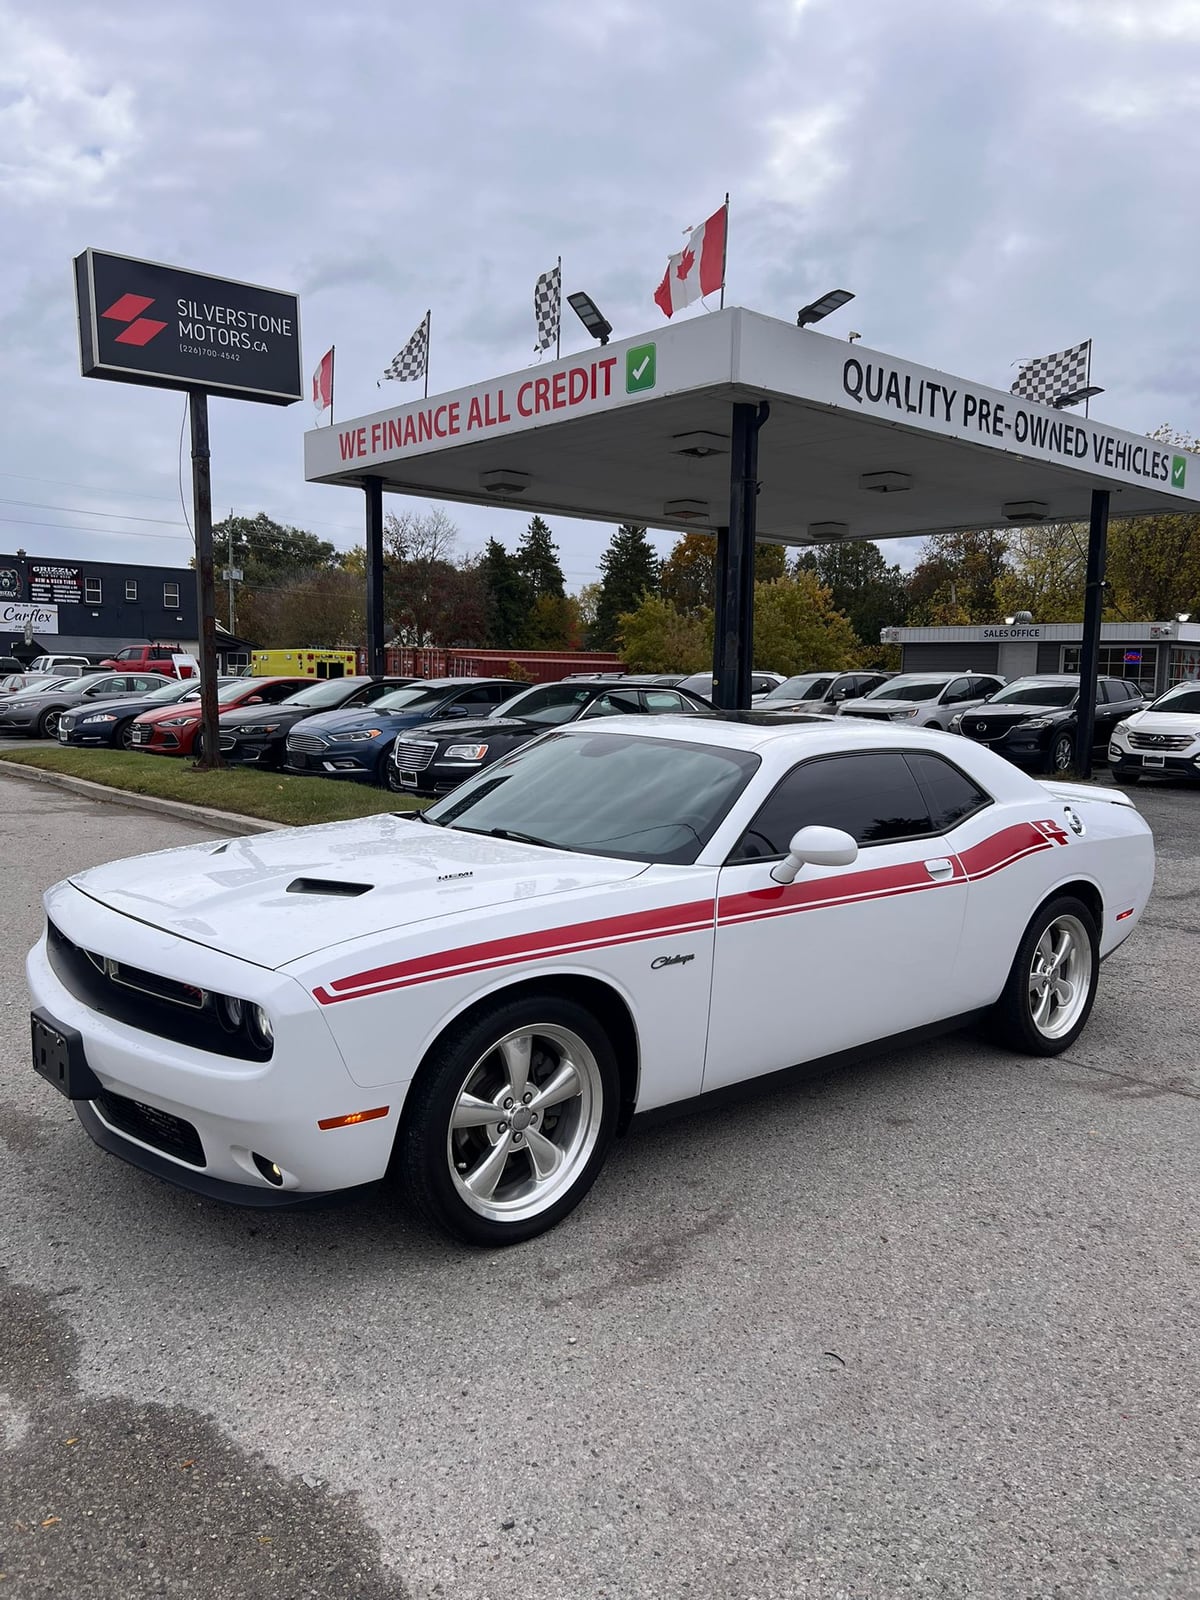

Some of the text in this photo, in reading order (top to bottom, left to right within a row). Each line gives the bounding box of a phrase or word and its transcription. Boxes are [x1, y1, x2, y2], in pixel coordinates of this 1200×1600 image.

[177, 298, 292, 337] SILVERSTONE
[179, 343, 241, 362] (226)700-4542
[338, 356, 618, 461] WE FINANCE ALL CREDIT
[842, 357, 1169, 482] QUALITY PRE-OWNED VEHICLES
[32, 566, 78, 575] GRIZZLY
[3, 606, 52, 623] Carflex
[983, 629, 1040, 638] SALES OFFICE
